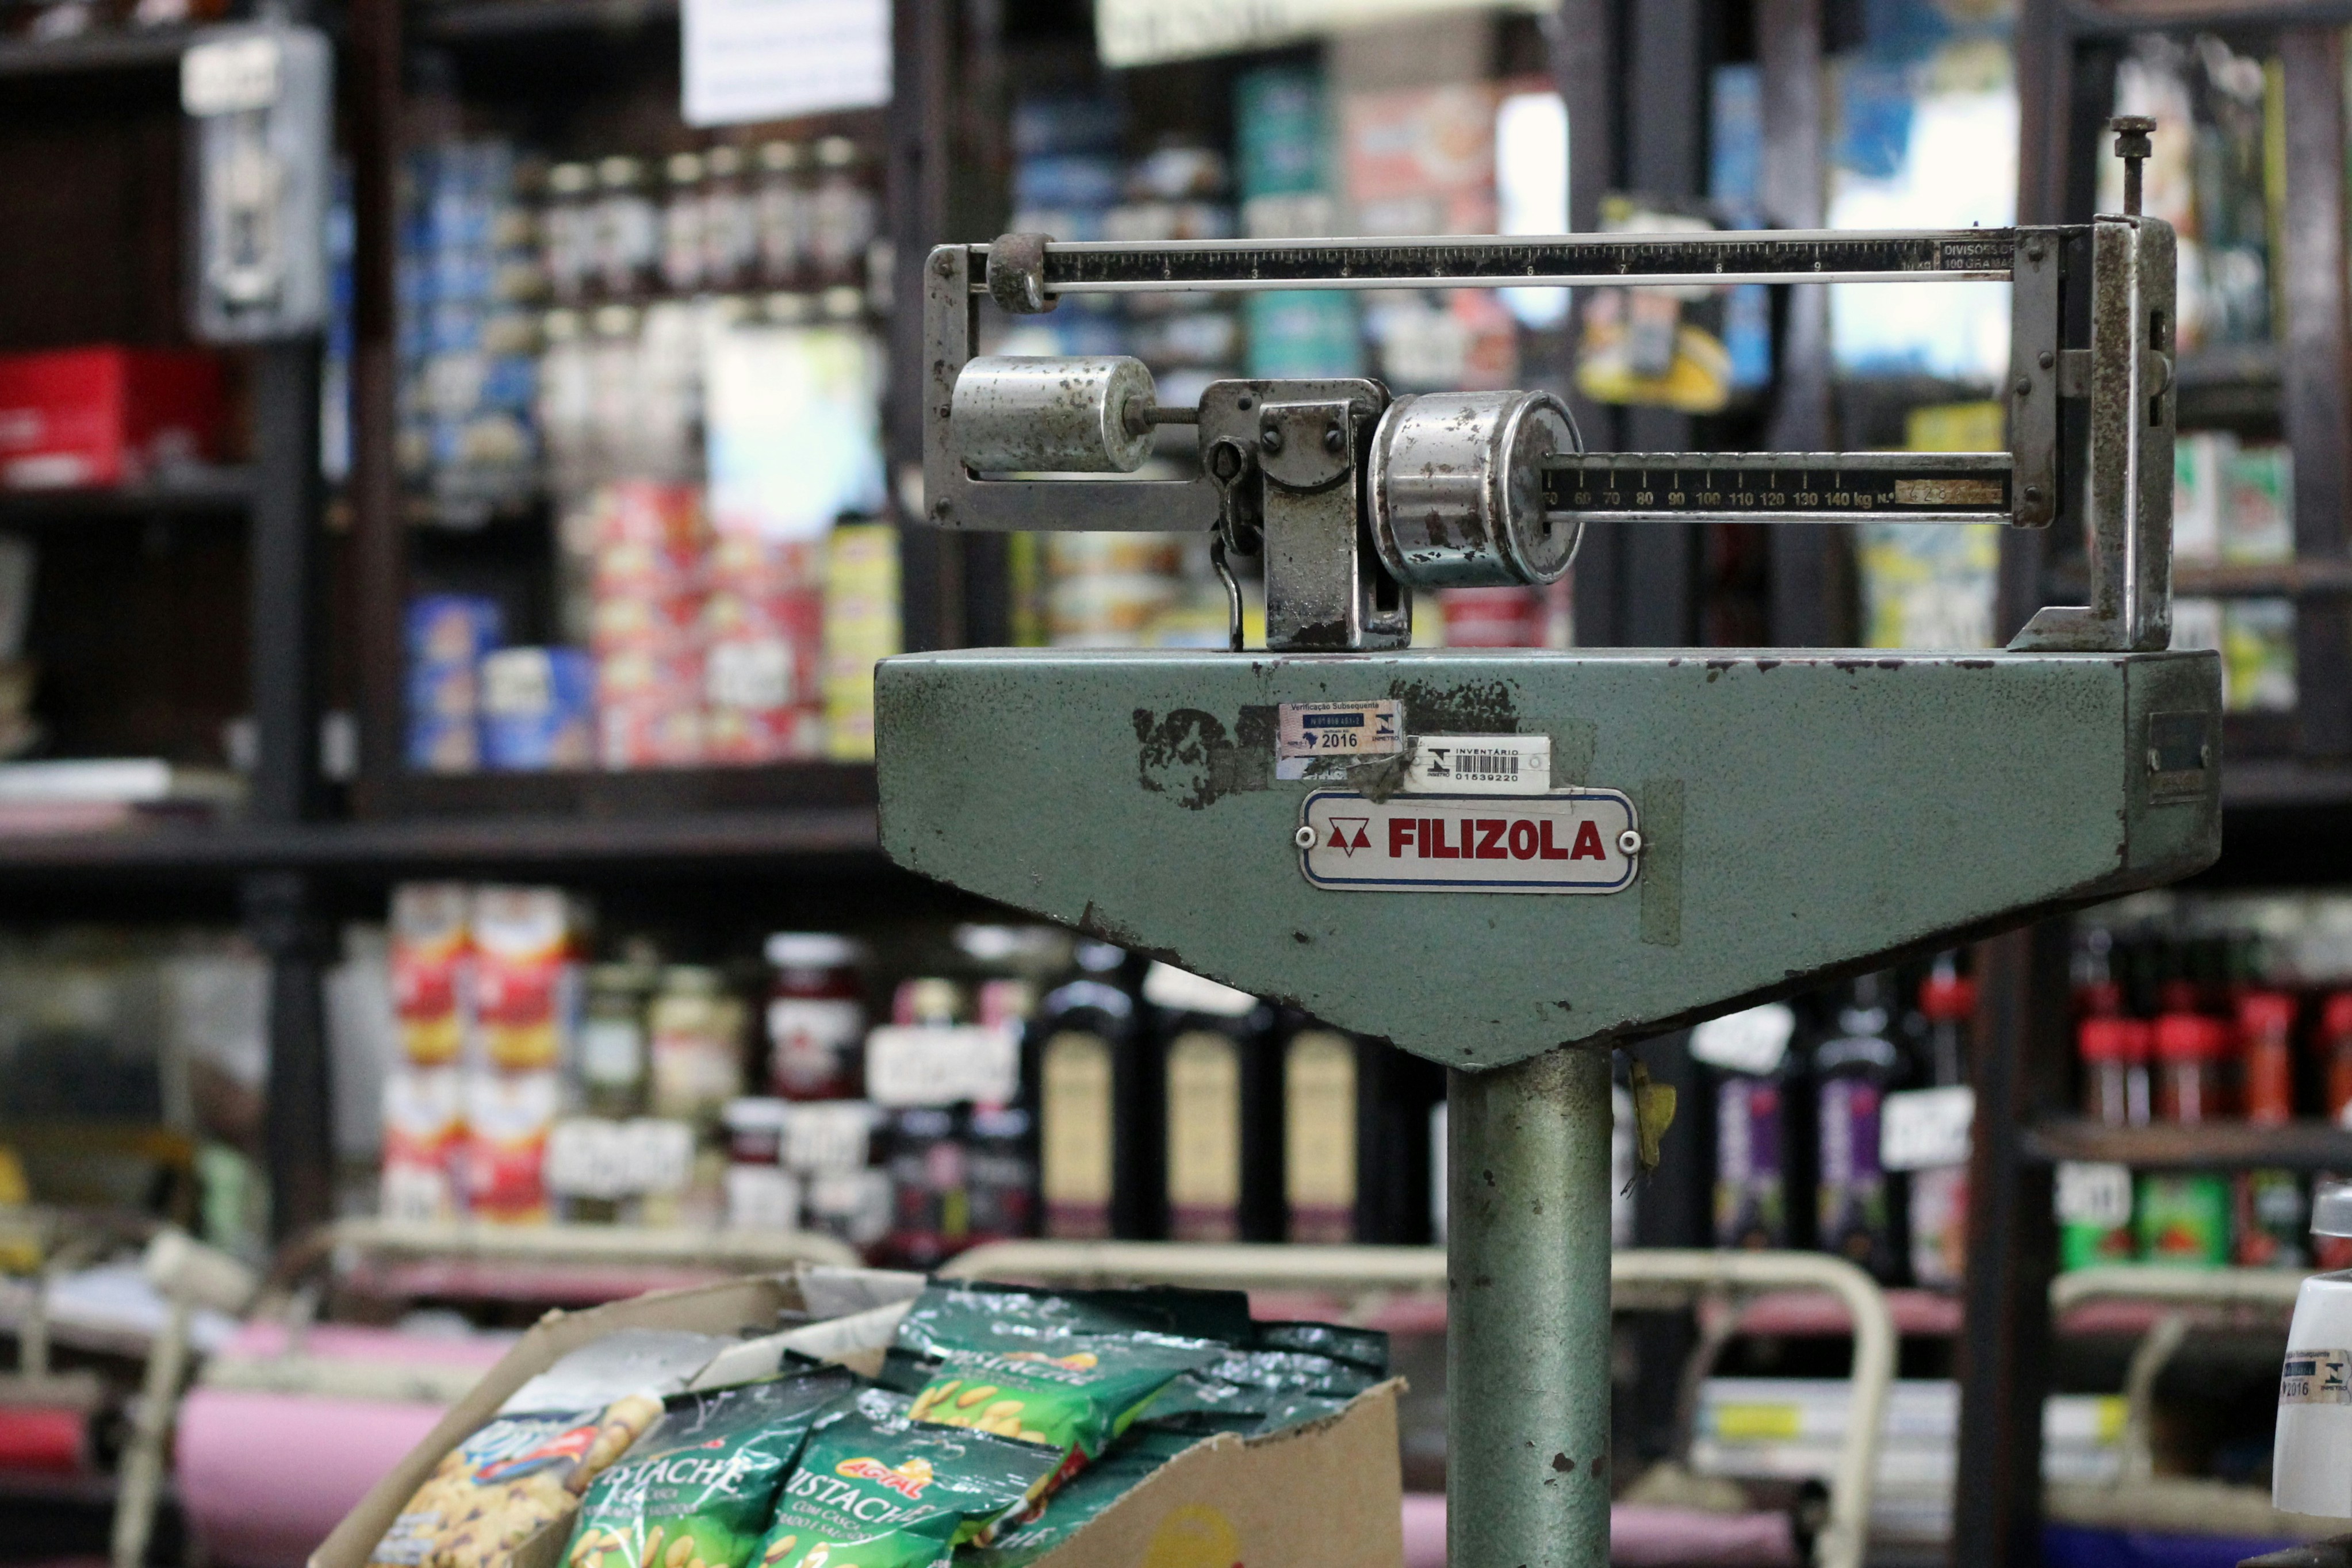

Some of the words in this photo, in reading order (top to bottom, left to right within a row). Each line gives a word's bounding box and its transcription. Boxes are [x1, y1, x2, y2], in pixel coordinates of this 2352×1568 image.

[1163, 269, 1171, 279] 2
[1251, 269, 1258, 279] 3
[1342, 267, 1348, 277] 4
[1434, 269, 1441, 277] 5
[1620, 264, 1627, 274] 7
[1715, 263, 1723, 273] 8
[1814, 262, 1821, 272] 9
[1575, 492, 1591, 504] 60
[1603, 492, 1620, 505] 70
[1637, 492, 1653, 505] 80
[1668, 492, 1685, 505] 90
[1696, 492, 1721, 505] 100
[1729, 492, 1754, 505] 110
[1760, 492, 1785, 506] 120
[1793, 492, 1818, 506] 130
[1825, 492, 1850, 506] 140
[1854, 492, 1872, 509] kg
[1291, 703, 1330, 712] Verificação
[1332, 702, 1379, 711] Subsequente
[1322, 734, 1357, 747] 2016
[1455, 773, 1518, 782] 01539220
[1389, 818, 1606, 860] FILIZOLA
[2287, 1382, 2308, 1397] 2016
